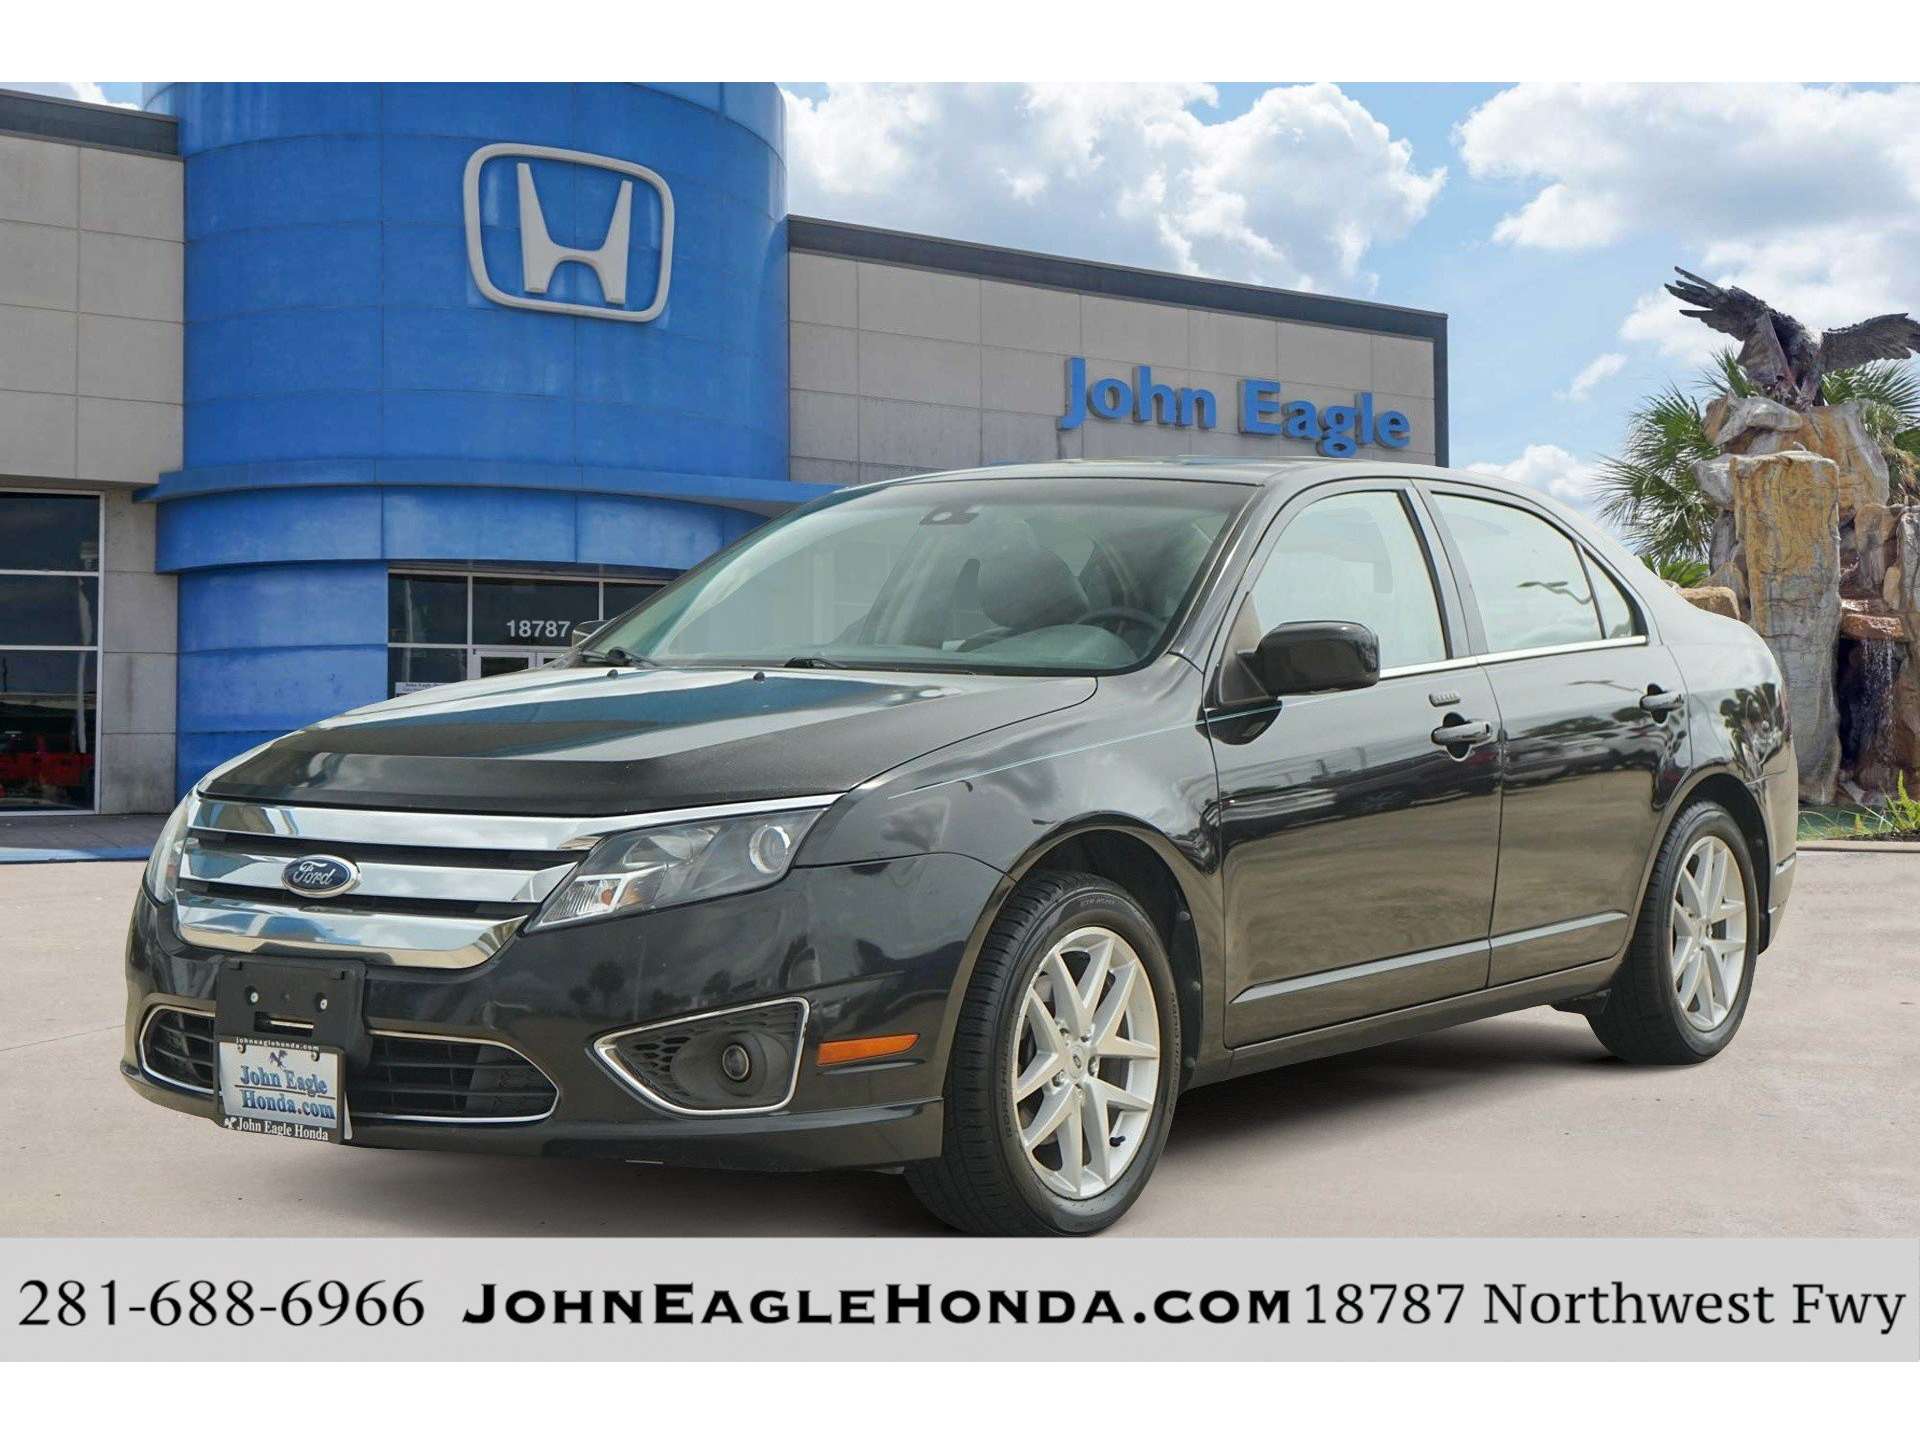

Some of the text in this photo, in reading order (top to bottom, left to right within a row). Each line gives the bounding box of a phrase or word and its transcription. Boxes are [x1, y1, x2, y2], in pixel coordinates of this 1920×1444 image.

[1056, 356, 1411, 458] John Eagle
[506, 620, 571, 638] 18787
[292, 860, 336, 885] Ford
[240, 1065, 328, 1098] John Eagle
[240, 1089, 336, 1120] Honda.com
[236, 1117, 329, 1141] John Eagle Honda
